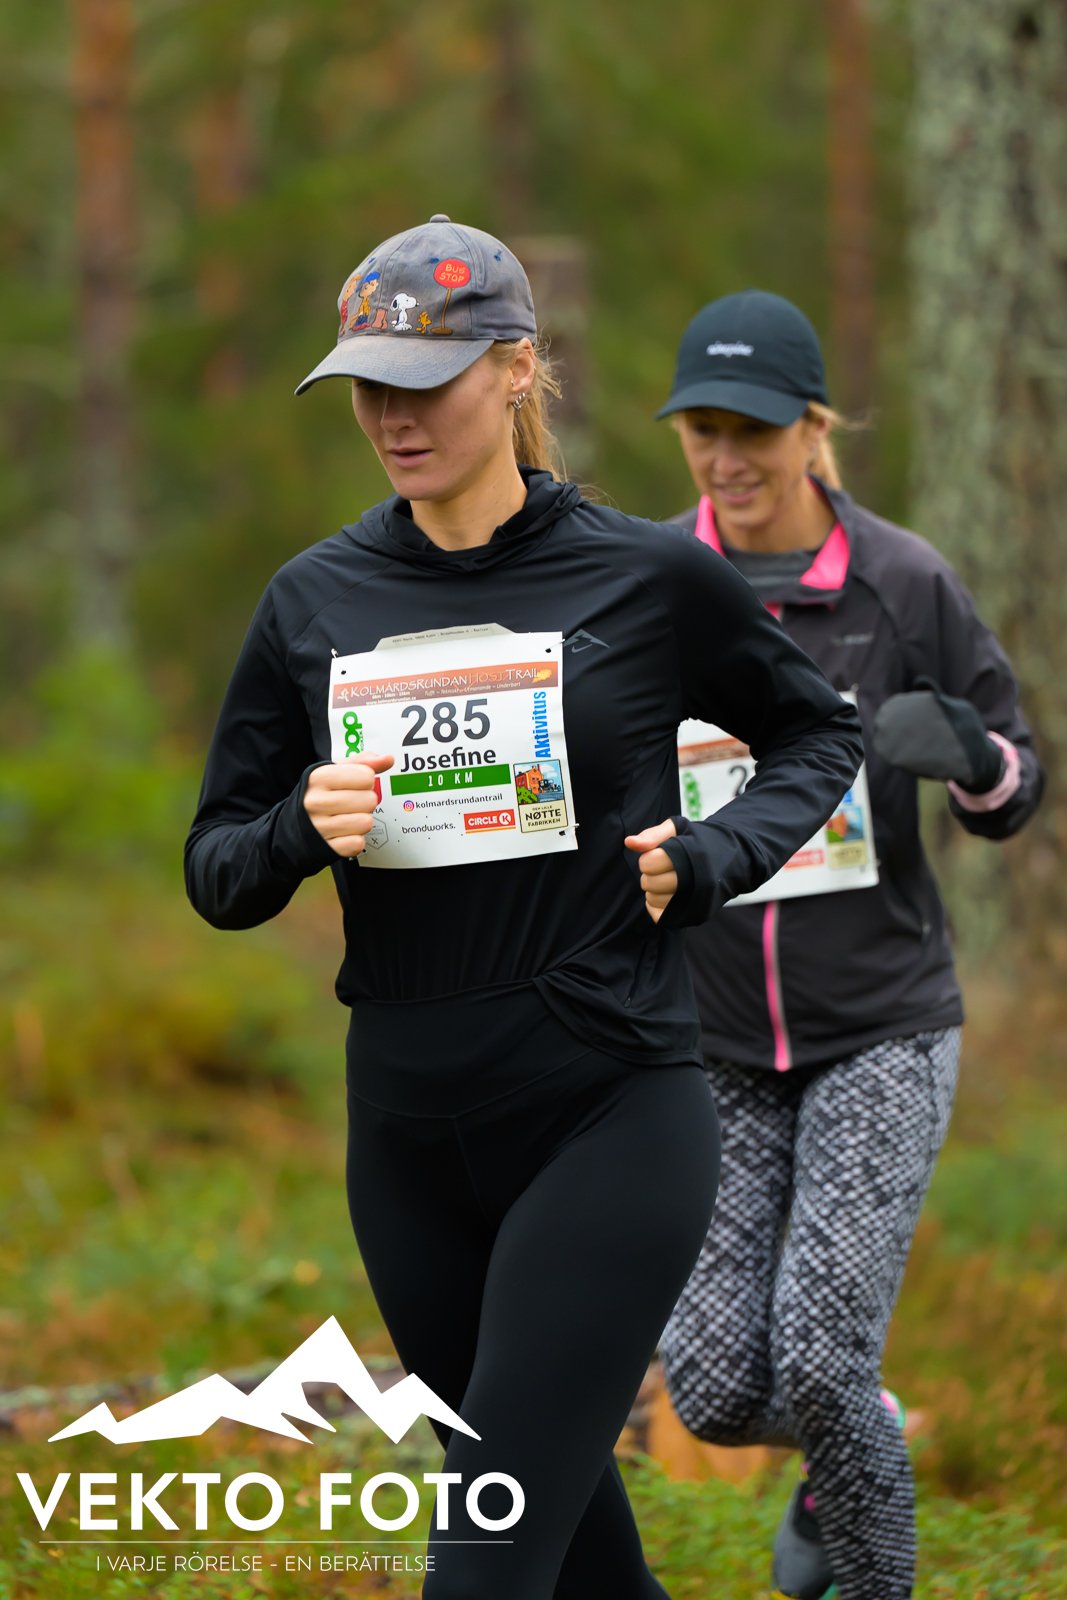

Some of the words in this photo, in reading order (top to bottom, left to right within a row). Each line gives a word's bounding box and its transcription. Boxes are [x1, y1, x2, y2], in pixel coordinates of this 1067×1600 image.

[445, 263, 466, 275] BUS
[440, 271, 465, 283] STOP
[505, 668, 538, 681] TRAIL
[401, 698, 491, 747] 285
[532, 691, 552, 758] Aktivitus
[400, 747, 497, 773] Josefine
[428, 775, 444, 787] 10
[454, 772, 473, 784] KM
[415, 793, 503, 809] kolmardsrundantrail
[525, 808, 562, 821] NØTTE
[467, 816, 498, 827] CIRCLE
[527, 818, 561, 827] FABRIKKEN
